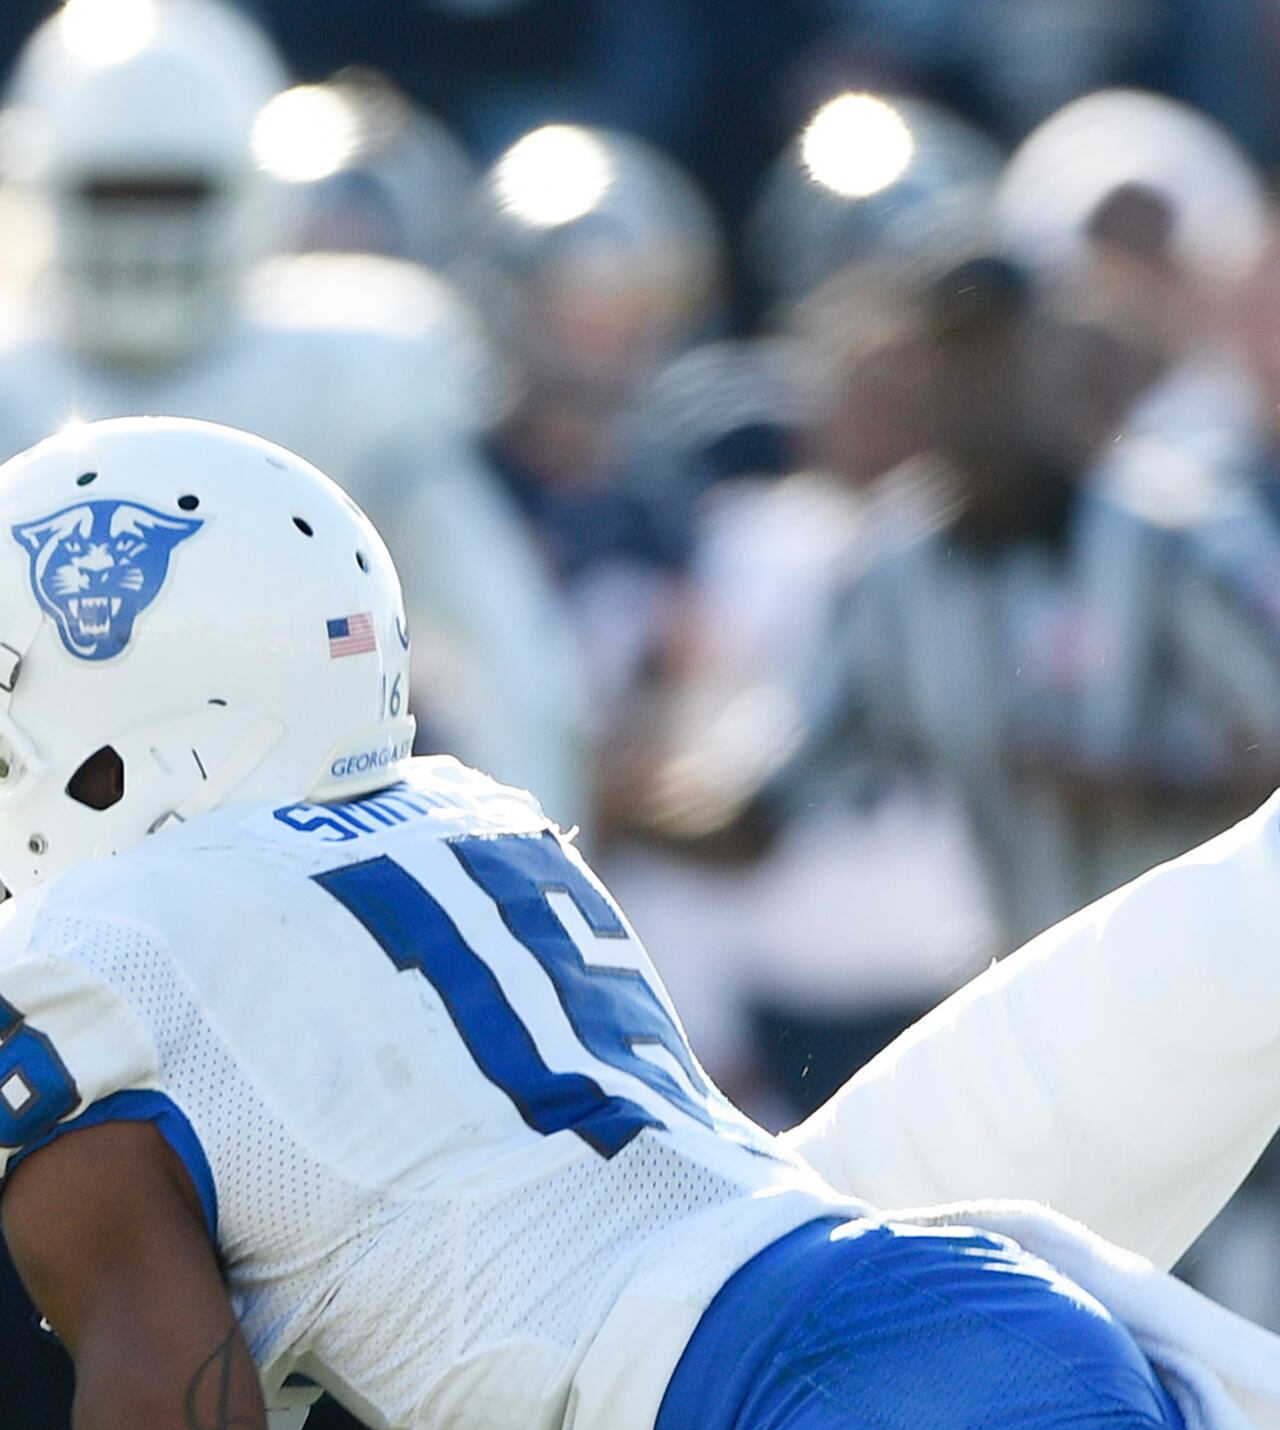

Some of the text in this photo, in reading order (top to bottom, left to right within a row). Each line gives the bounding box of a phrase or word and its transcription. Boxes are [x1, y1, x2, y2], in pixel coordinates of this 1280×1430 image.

[380, 671, 401, 722] 16
[331, 743, 399, 777] GEORGA
[309, 829, 719, 1161] 16
